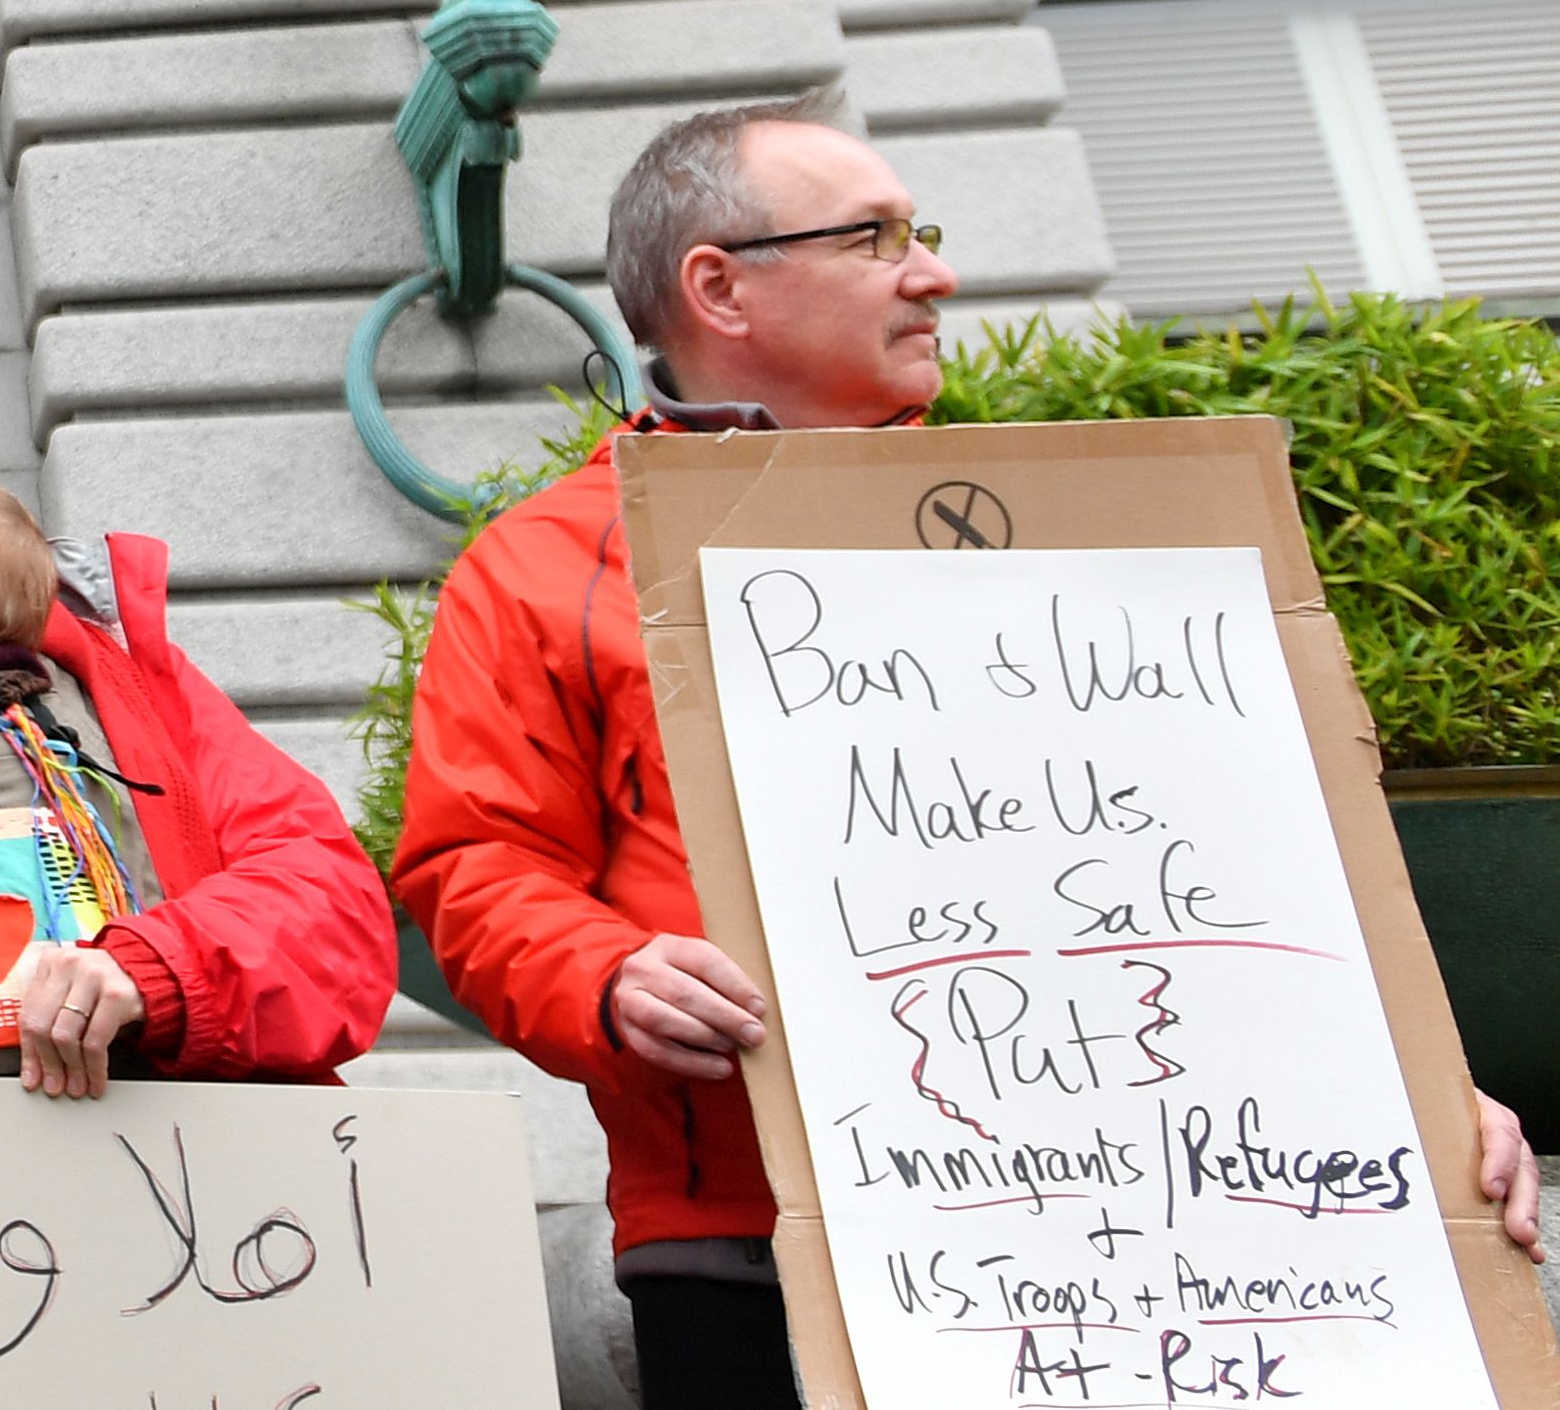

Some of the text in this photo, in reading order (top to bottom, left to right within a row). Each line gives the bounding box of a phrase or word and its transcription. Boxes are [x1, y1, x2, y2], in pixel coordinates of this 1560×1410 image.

[740, 569, 942, 716] Ban
[1051, 593, 1246, 718] Wall
[843, 744, 1037, 850] Make
[833, 839, 1271, 957] Less Safe
[976, 1253, 1118, 1344] Troops
[1174, 1251, 1396, 1325] Americans
